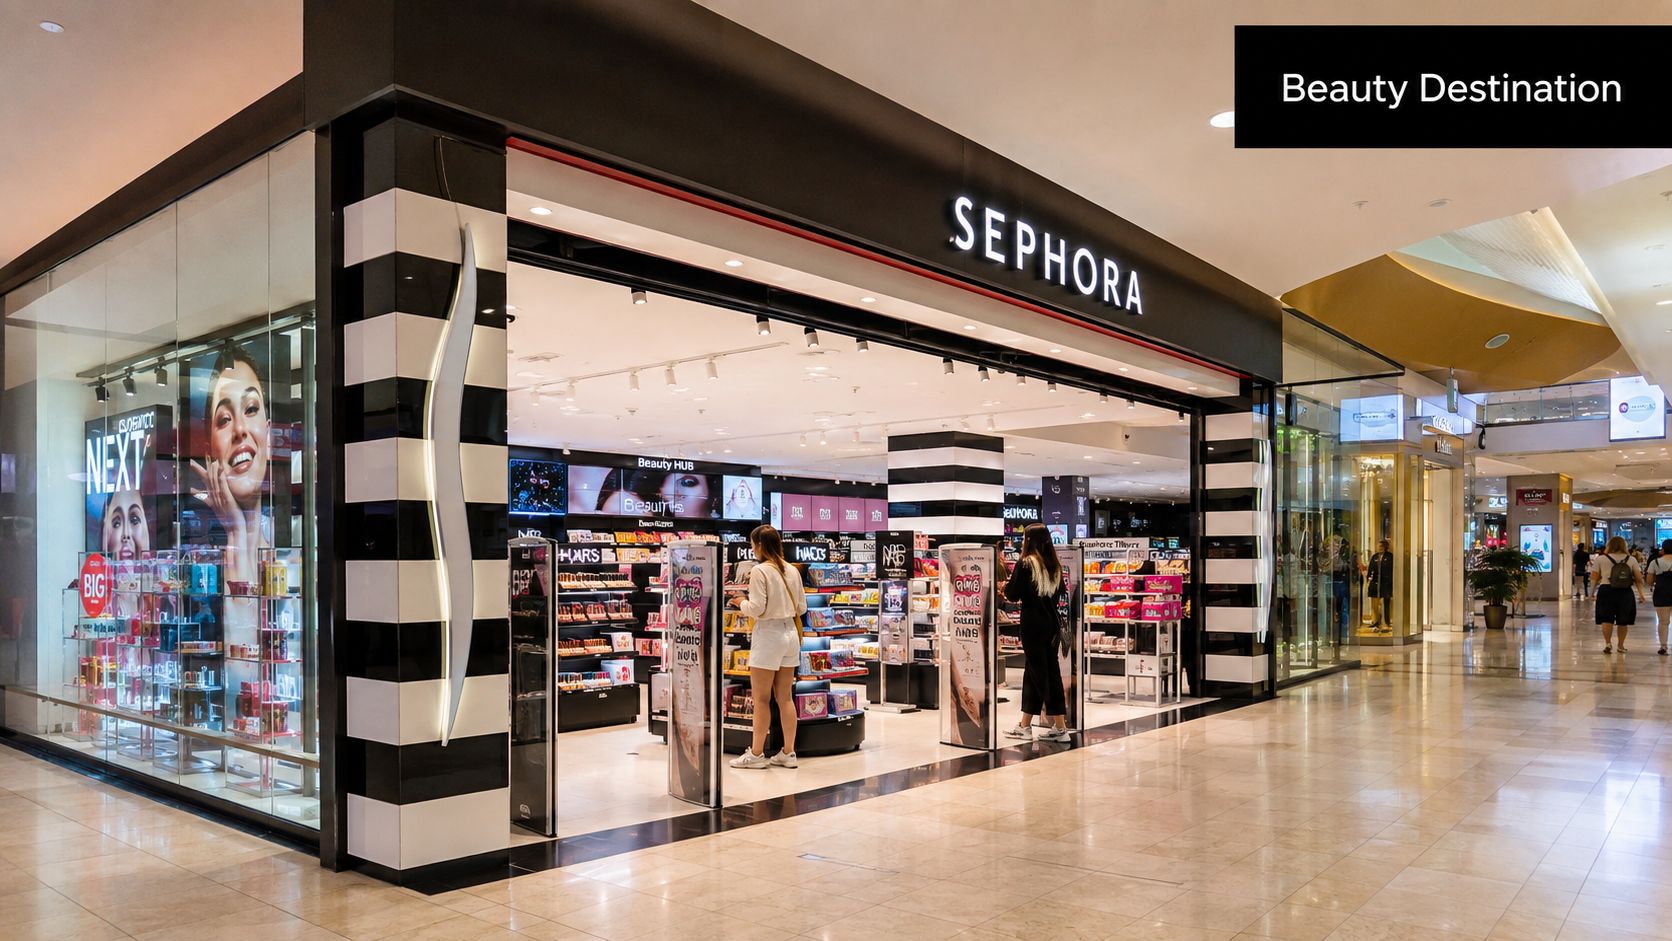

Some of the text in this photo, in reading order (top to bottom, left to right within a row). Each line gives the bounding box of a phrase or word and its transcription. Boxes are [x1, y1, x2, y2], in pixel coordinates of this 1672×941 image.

[954, 196, 1143, 315] SEPHORA
[86, 430, 145, 495] NEXT
[638, 457, 694, 471] Beauty HUB
[84, 573, 105, 599] BIG
